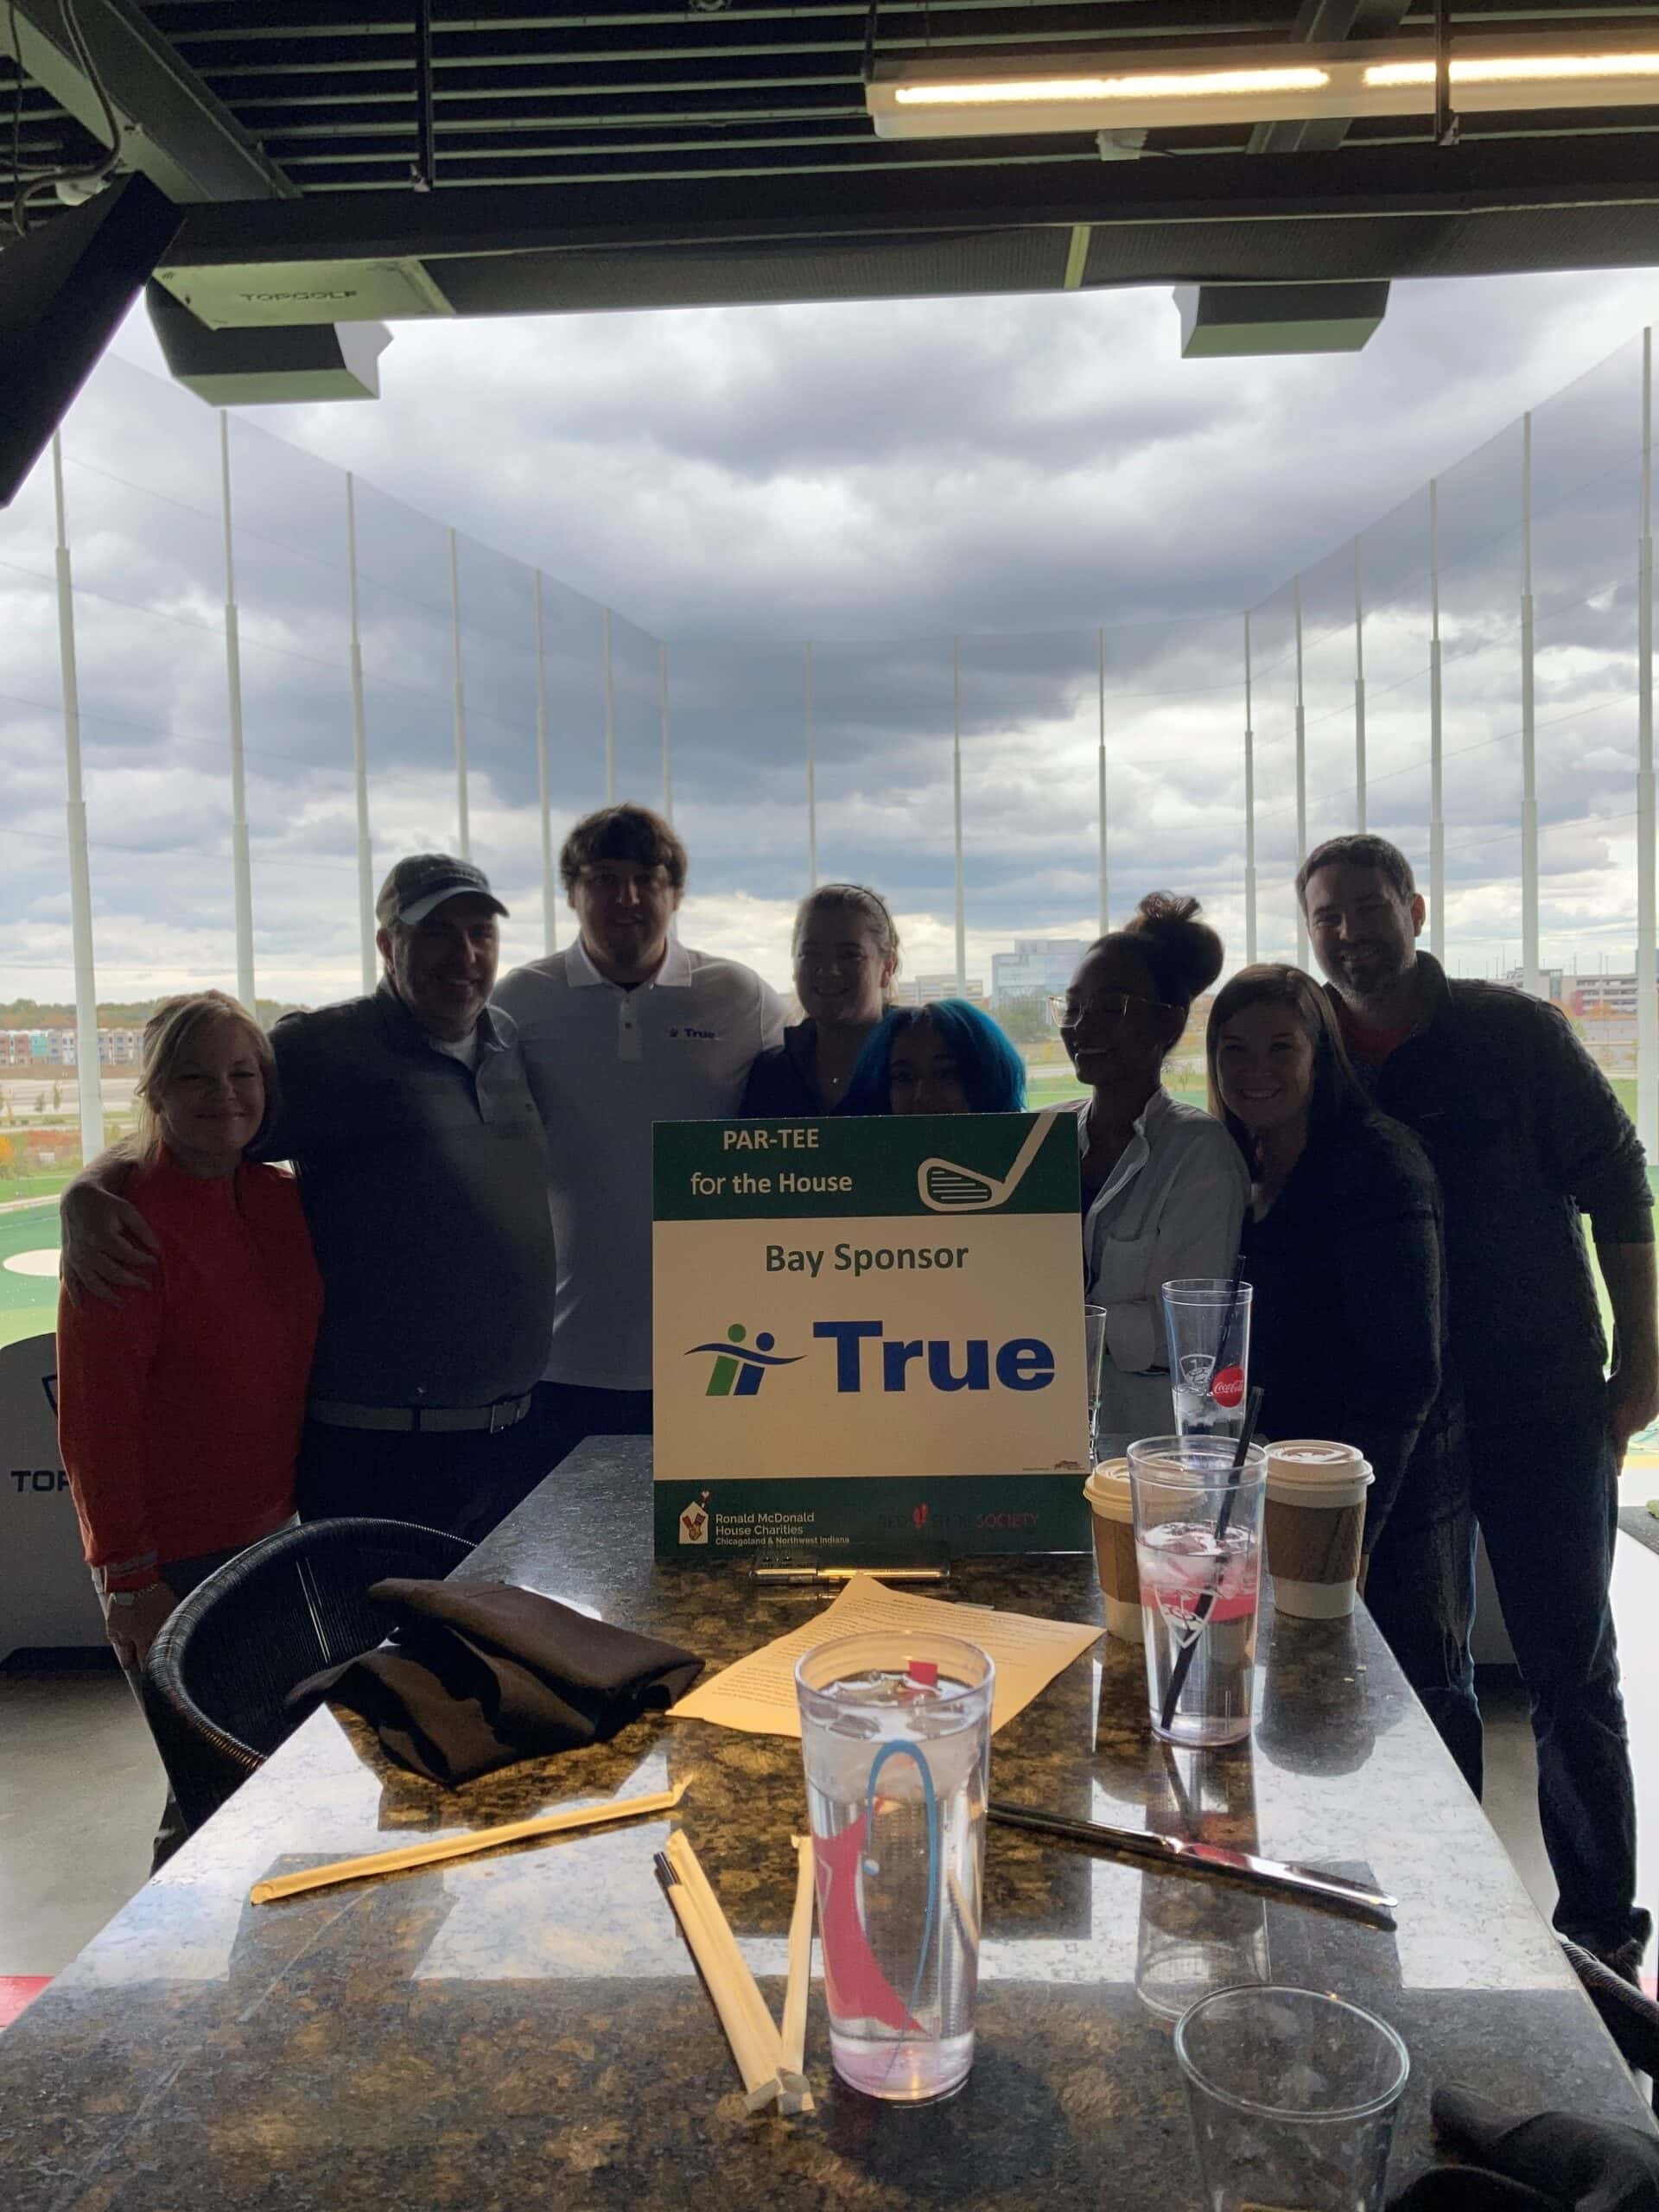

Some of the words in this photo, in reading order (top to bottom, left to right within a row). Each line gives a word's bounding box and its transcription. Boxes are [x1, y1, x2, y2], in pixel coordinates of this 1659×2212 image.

[240, 290, 358, 301] TOPGOLF
[684, 1028, 717, 1038] True
[722, 1128, 819, 1150] PAR-TEE
[690, 1173, 726, 1195] for
[732, 1173, 772, 1194] the
[779, 1172, 853, 1193] House
[766, 1244, 824, 1278] Bay
[834, 1243, 969, 1276] Sponsor
[813, 1320, 1056, 1393] True
[715, 1513, 755, 1524] Ronald
[758, 1512, 815, 1523] McDonald
[976, 1513, 1039, 1528] SOCIETY
[715, 1525, 752, 1535] House
[754, 1524, 804, 1535] Charities
[715, 1536, 766, 1547] Chicagoland
[776, 1535, 818, 1545] Northwest
[820, 1535, 849, 1543] Indiana
